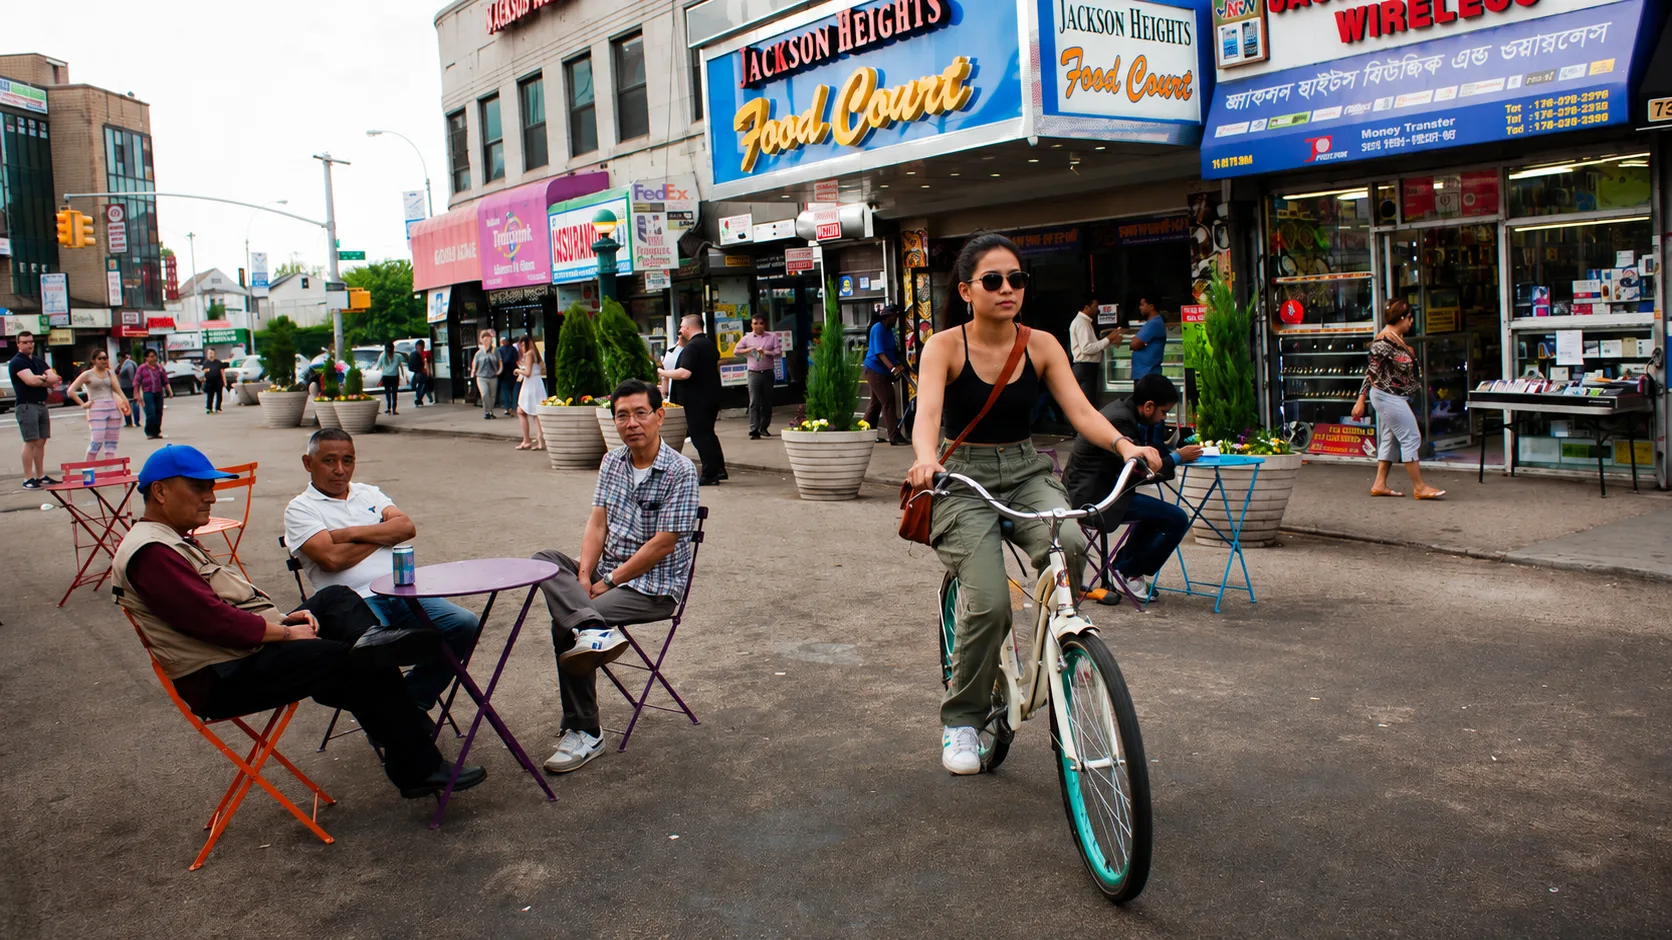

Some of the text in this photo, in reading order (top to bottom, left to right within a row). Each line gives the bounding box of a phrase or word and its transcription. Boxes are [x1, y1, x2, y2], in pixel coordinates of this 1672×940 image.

[739, 0, 941, 88] JACKSON HEIGHTS
[1060, 0, 1191, 46] JACKSON HEIGHTS
[1334, 0, 1538, 43] WIRELE
[1060, 46, 1193, 103] Food Court
[733, 56, 973, 173] Food Court
[633, 184, 689, 200] FedEx
[552, 222, 602, 264] INSURANC
